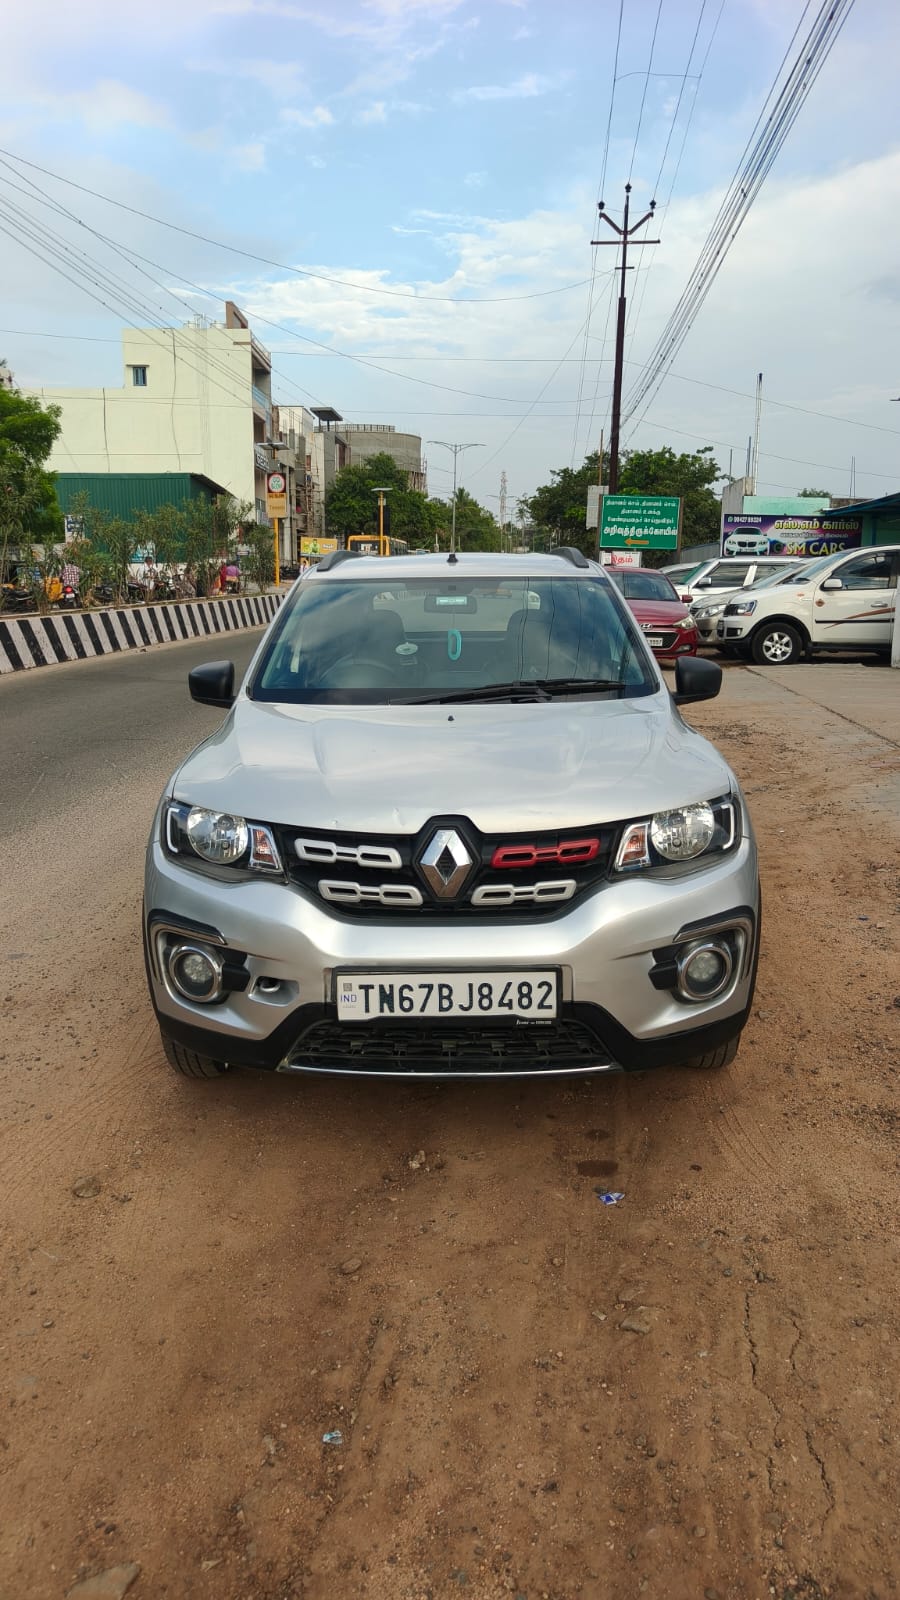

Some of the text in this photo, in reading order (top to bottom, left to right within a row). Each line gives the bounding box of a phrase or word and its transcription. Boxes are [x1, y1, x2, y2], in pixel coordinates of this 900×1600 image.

[786, 542, 845, 555] SM CARS
[358, 980, 552, 1013] TN67BJ8482
